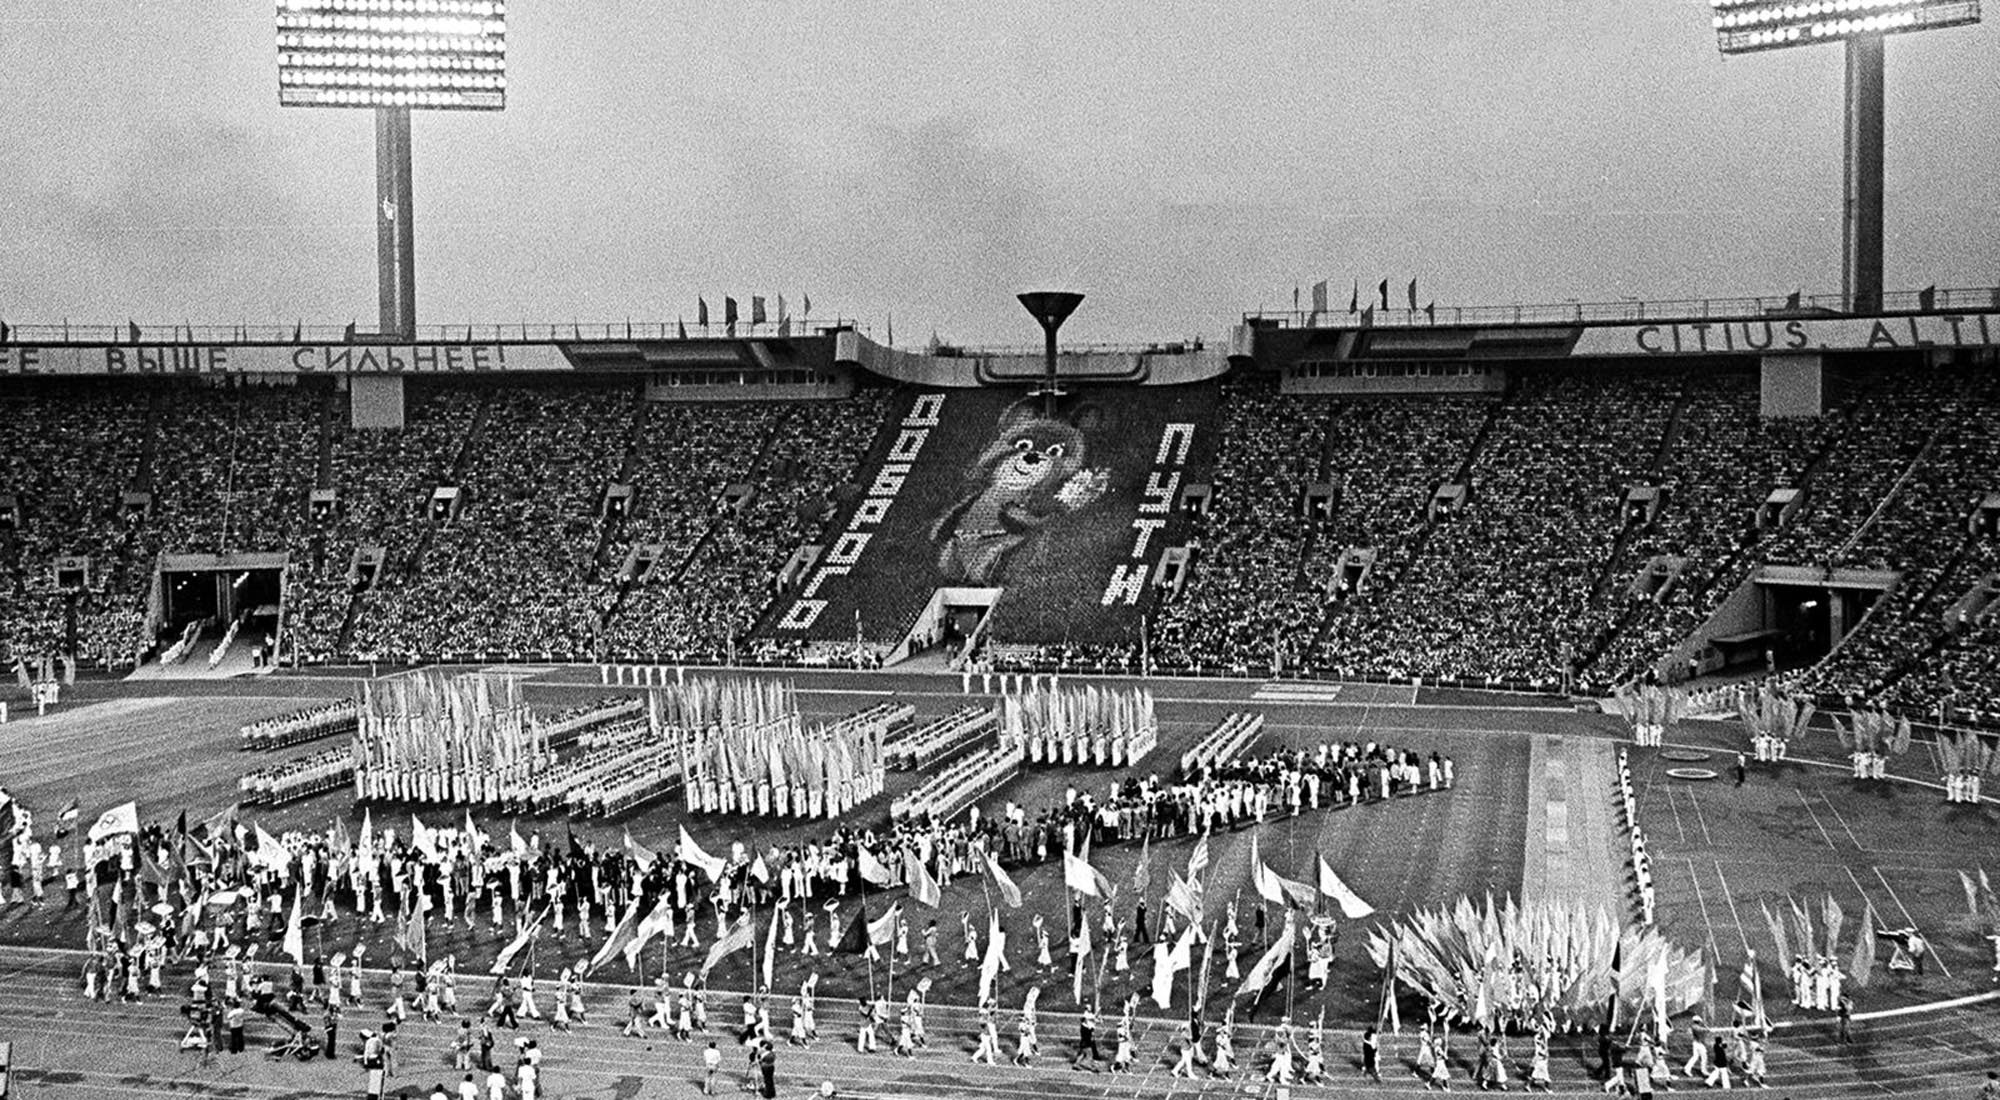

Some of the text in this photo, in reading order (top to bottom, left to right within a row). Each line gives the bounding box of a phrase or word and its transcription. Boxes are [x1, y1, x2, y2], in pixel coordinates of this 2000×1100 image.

[106, 347, 243, 374] ВЫШЕ.
[292, 346, 505, 373] СИЛЬНЕЕ!
[1636, 321, 1826, 353] CITIUS.
[777, 394, 946, 629] ДОБРОГО
[1101, 423, 1195, 606] ПУТИ
